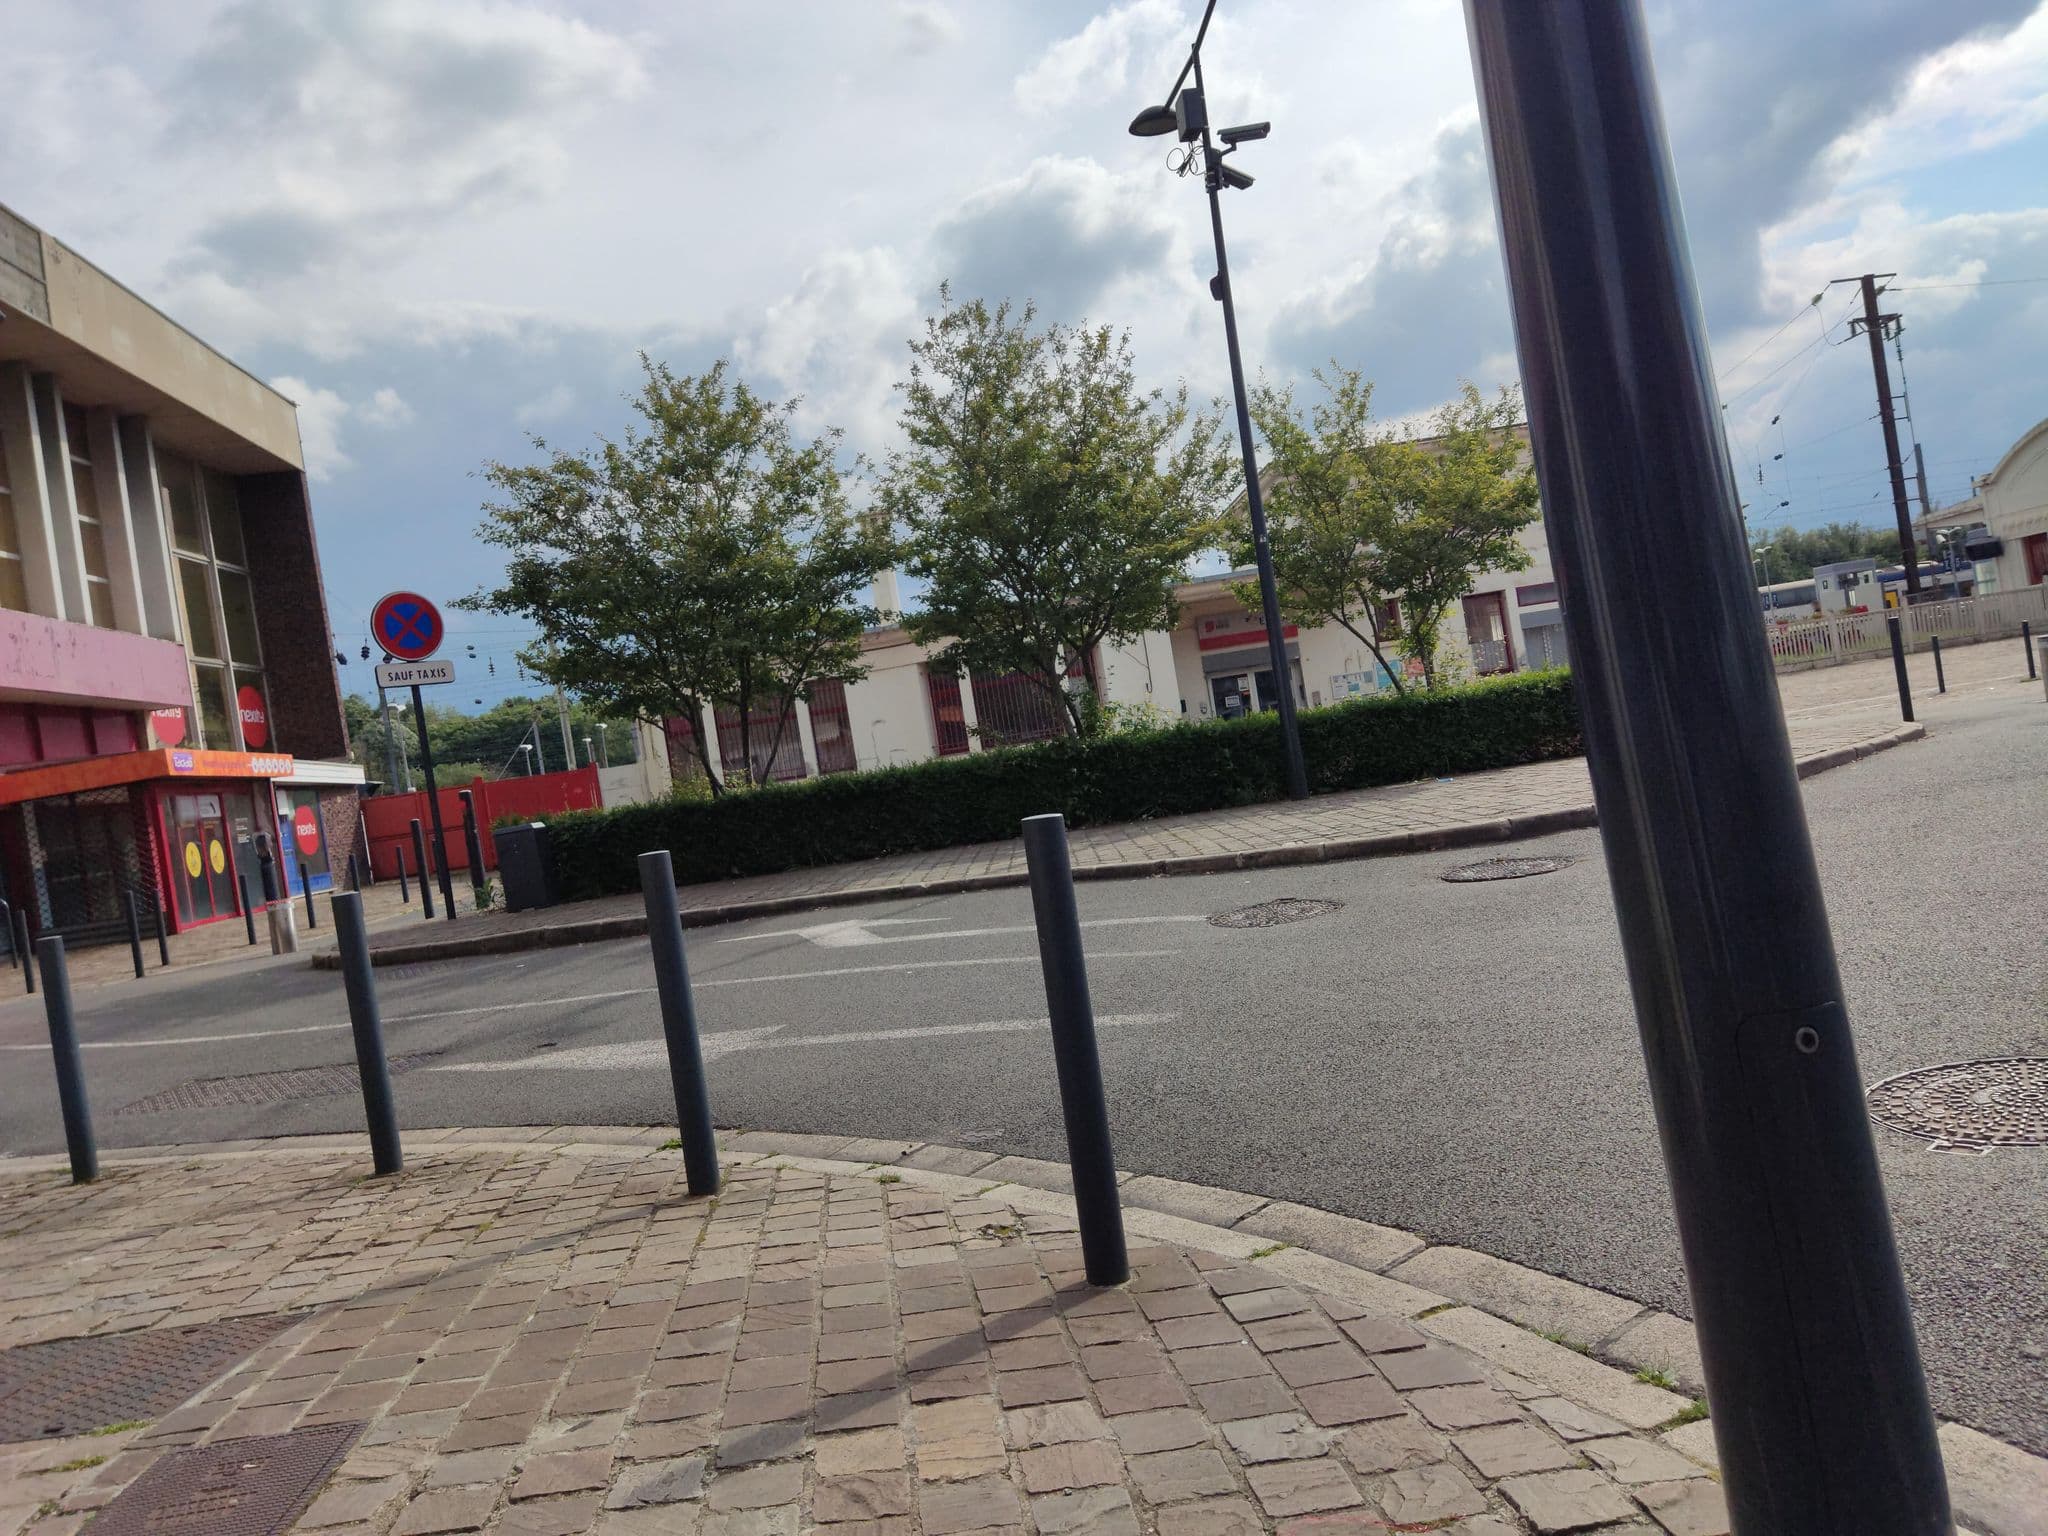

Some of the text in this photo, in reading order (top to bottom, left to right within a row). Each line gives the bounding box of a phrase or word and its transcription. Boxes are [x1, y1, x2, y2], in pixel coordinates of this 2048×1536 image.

[387, 668, 447, 682] SAUF TAXIS
[239, 709, 265, 724] nexity
